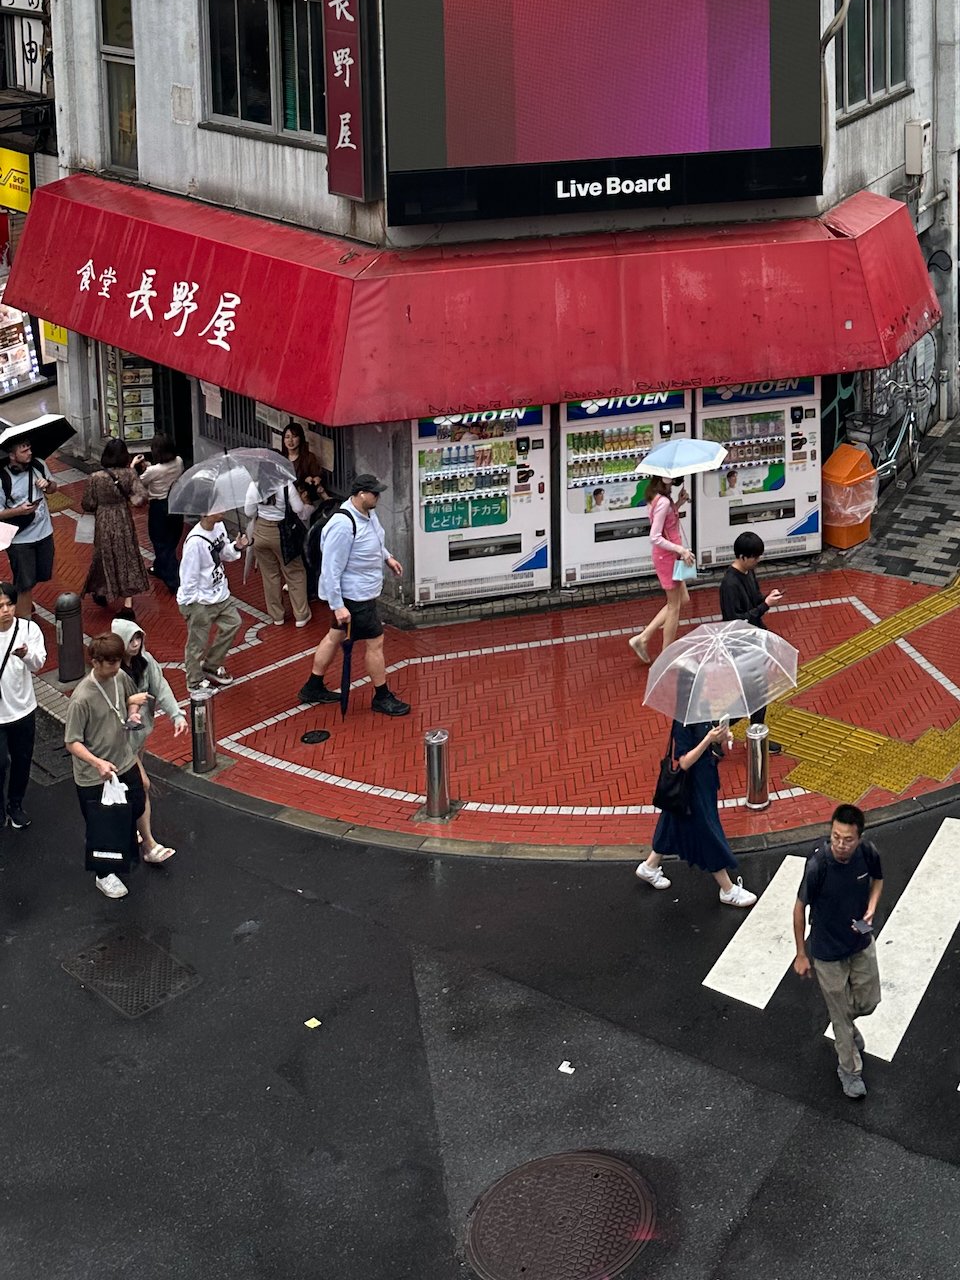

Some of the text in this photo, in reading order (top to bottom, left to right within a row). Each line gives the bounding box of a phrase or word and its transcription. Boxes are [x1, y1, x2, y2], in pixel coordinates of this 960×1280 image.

[557, 173, 671, 198] Live Board
[77, 259, 241, 351] 食堂 長野屋
[741, 381, 774, 396] ITO
[775, 378, 800, 391] EN
[608, 394, 640, 410] ITO
[643, 391, 669, 405] EN
[462, 407, 527, 423] ITO EN
[429, 503, 464, 515] 新宿に
[471, 504, 501, 517] チカラ
